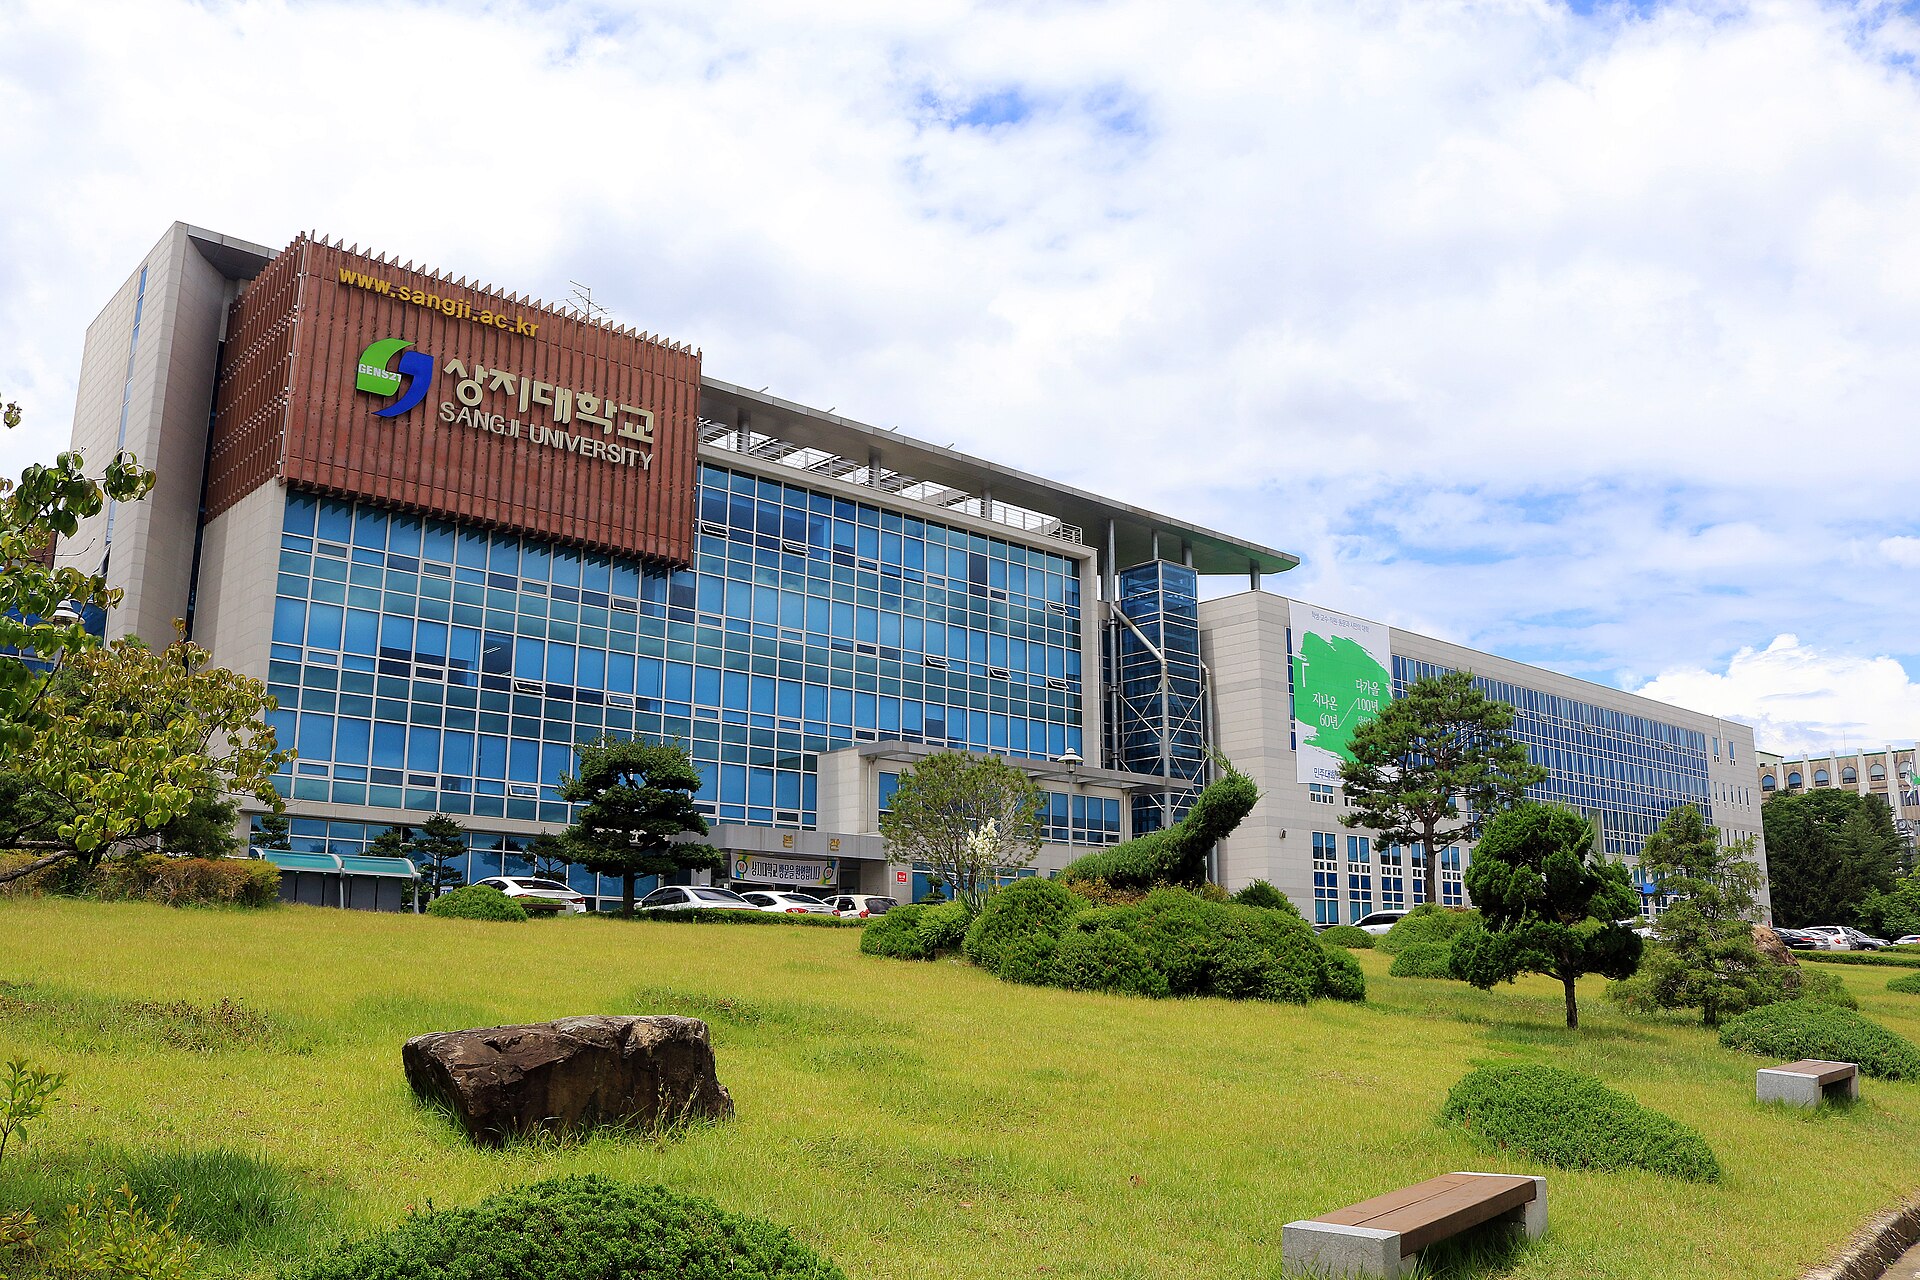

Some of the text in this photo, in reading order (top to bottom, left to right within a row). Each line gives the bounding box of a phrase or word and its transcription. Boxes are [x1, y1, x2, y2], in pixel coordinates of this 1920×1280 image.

[339, 267, 539, 337] www.sangji.ac.kr
[358, 363, 402, 382] GENS21
[443, 358, 655, 444] 상지대학교
[439, 401, 654, 471] SANGJI UNIVERSITY
[1355, 678, 1380, 697] 다가올
[1312, 692, 1338, 711] 지나온
[1357, 698, 1379, 714] 100년
[1320, 712, 1339, 729] 60년
[751, 861, 778, 878] 상지대학교
[778, 864, 795, 880] 방문을
[795, 864, 821, 881] 환영합니다
